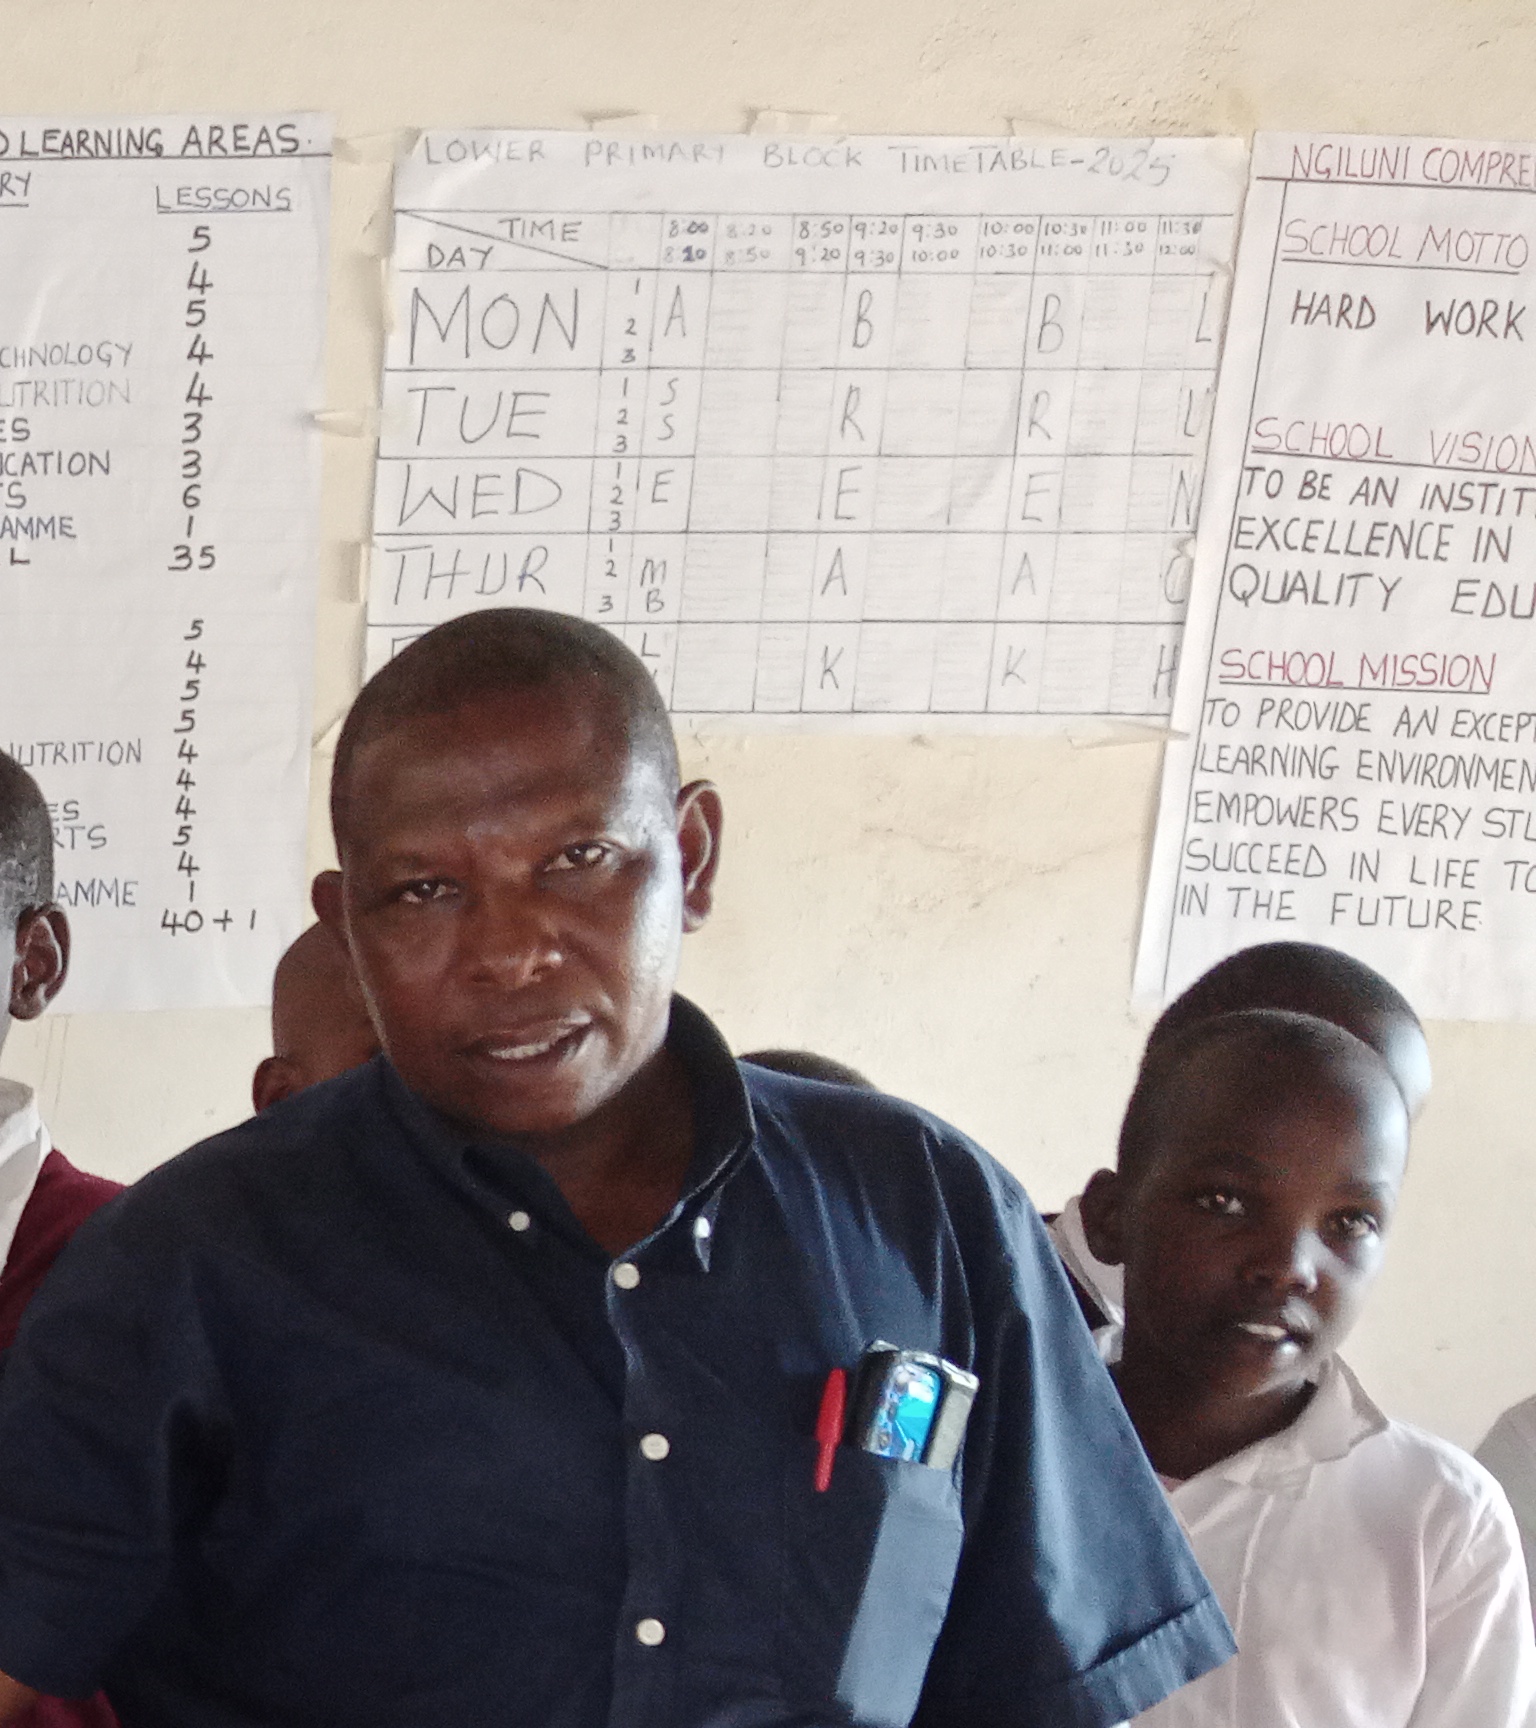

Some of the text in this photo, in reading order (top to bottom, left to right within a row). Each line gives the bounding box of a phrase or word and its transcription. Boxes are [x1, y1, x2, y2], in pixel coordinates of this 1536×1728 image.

[21, 128, 164, 158] LEARNING
[425, 136, 863, 168] LOWER PRIMARY BLOCK
[1290, 143, 1411, 181] NGILUNI
[155, 184, 292, 212] LESSONS
[498, 216, 583, 243] TIME
[1281, 218, 1529, 269] SCHOOL MOTTO
[427, 243, 494, 271] DAY
[410, 284, 579, 366] MON
[1291, 289, 1527, 342] HARD WORK
[407, 386, 551, 446] TUE
[1251, 416, 1393, 459] SCHOOL
[398, 463, 563, 528] WED
[1244, 466, 1400, 508] TO BE AN
[167, 545, 216, 571] 35
[1234, 515, 1513, 563] EXCELLENCE IN
[384, 545, 549, 606] THUR
[1229, 562, 1403, 613] QUALITY
[1218, 648, 1497, 693] SCHOOL MISSION
[1207, 698, 1439, 739] TO PROVIDE AN
[1199, 743, 1340, 780] LEARNING
[1194, 791, 1472, 841] EMPOWERS EVERY
[1185, 838, 1480, 890] SUCCEED IN LIFE
[1180, 882, 1210, 918] IN
[1228, 886, 1297, 922] THE
